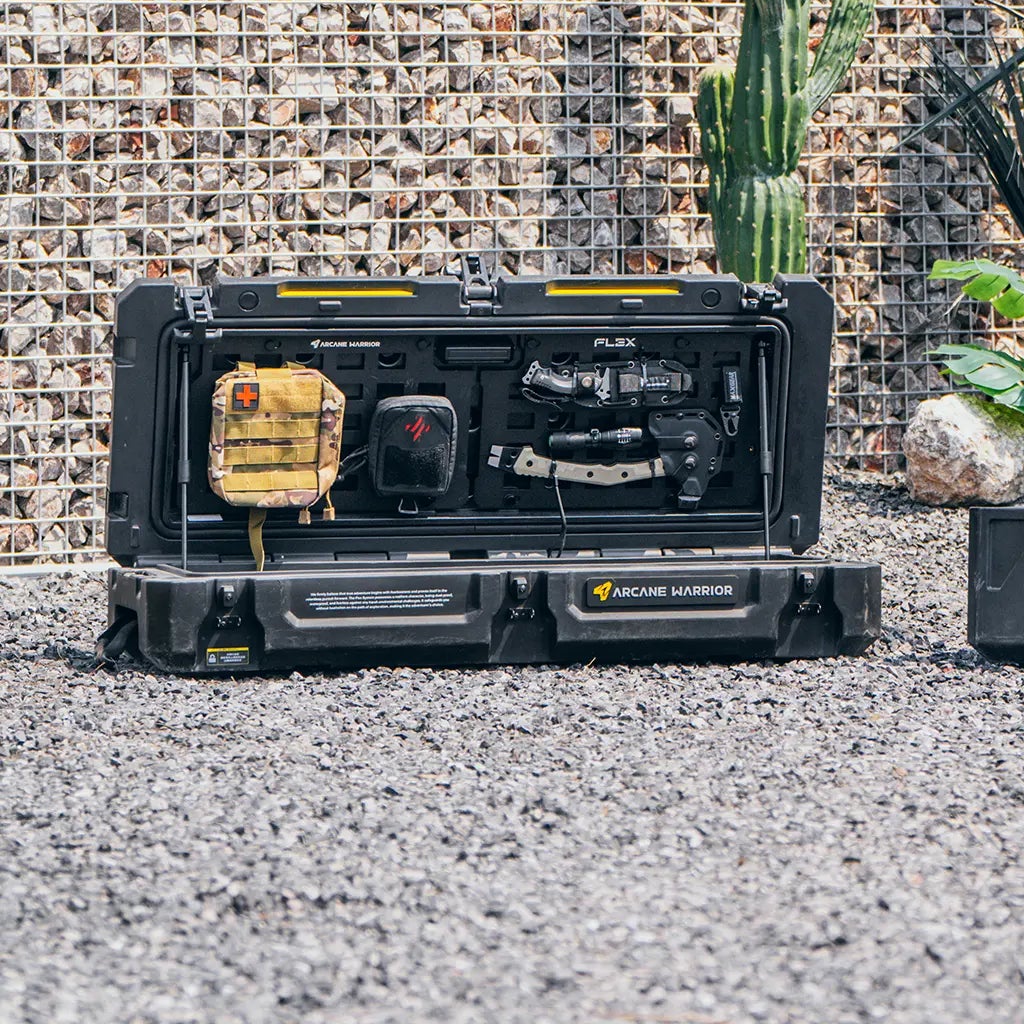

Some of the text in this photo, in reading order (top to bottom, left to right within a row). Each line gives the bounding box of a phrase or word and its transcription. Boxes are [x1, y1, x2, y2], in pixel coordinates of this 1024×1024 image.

[593, 337, 636, 347] FLEX
[612, 585, 733, 598] ARCANE WARRIOR
